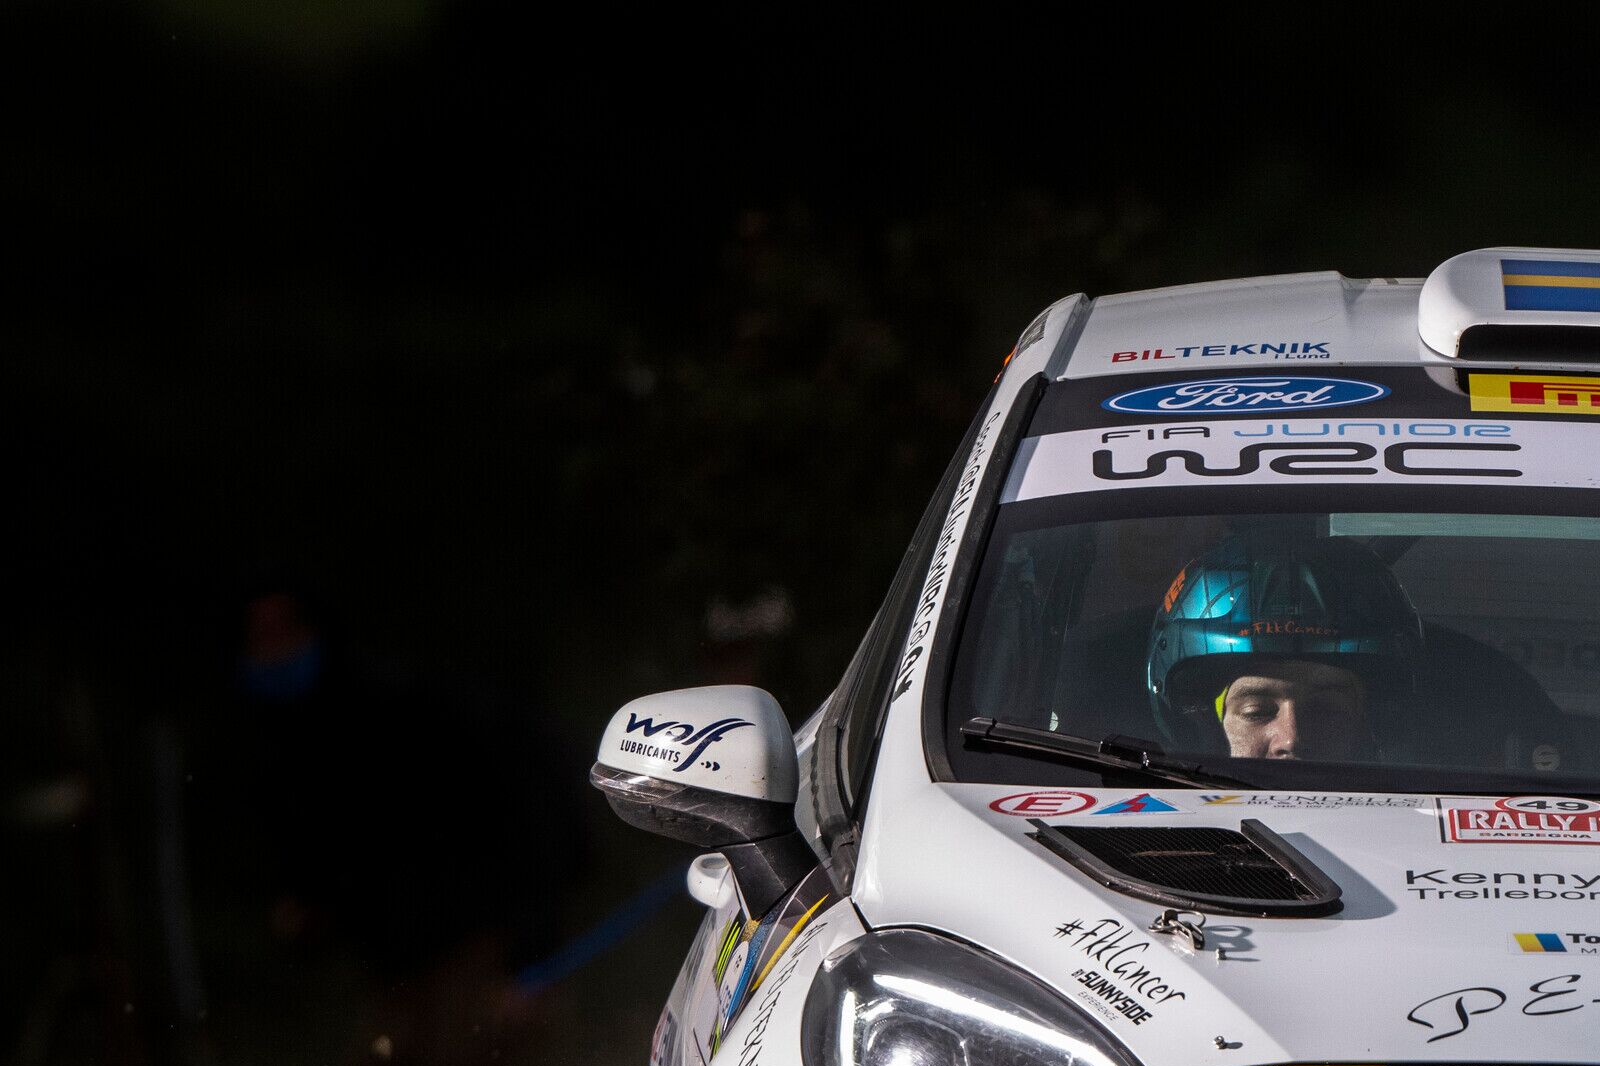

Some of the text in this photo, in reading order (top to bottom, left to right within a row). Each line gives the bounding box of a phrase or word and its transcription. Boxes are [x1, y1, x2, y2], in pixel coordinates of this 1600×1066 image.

[1111, 342, 1331, 363] BILTEKNIK
[1287, 352, 1331, 360] Lund
[1157, 380, 1336, 410] Ford
[1101, 423, 1512, 444] FIA JUNIOR
[1092, 442, 1523, 480] WRC
[620, 738, 682, 763] LUBRICANTS
[1516, 800, 1589, 811] 49
[1467, 809, 1577, 831] RALLY
[1077, 970, 1153, 1026] SUNNYSIDE
